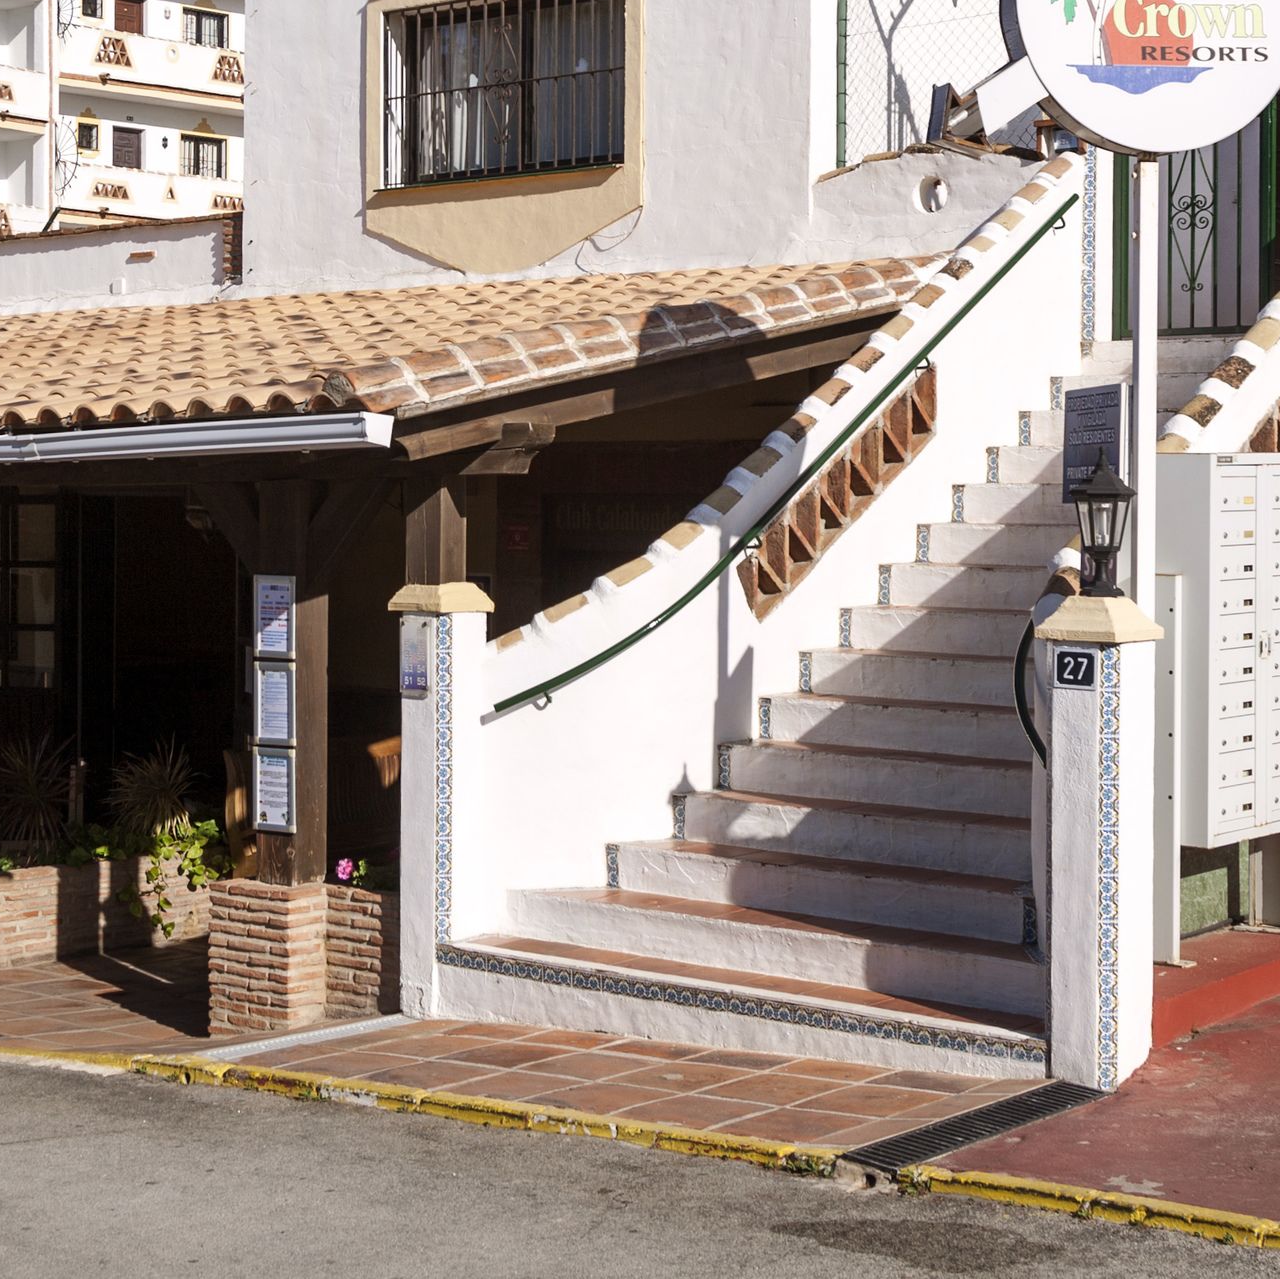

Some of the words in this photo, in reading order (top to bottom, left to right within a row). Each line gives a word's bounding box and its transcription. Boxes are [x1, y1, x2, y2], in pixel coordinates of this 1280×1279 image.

[1141, 45, 1268, 62] RESORTS
[1083, 429, 1115, 443] RESIDENTES
[1066, 465, 1087, 479] PRIVATE
[556, 502, 591, 530] Club
[1063, 656, 1088, 680] 27
[404, 676, 413, 685] 51
[417, 677, 426, 686] 52
